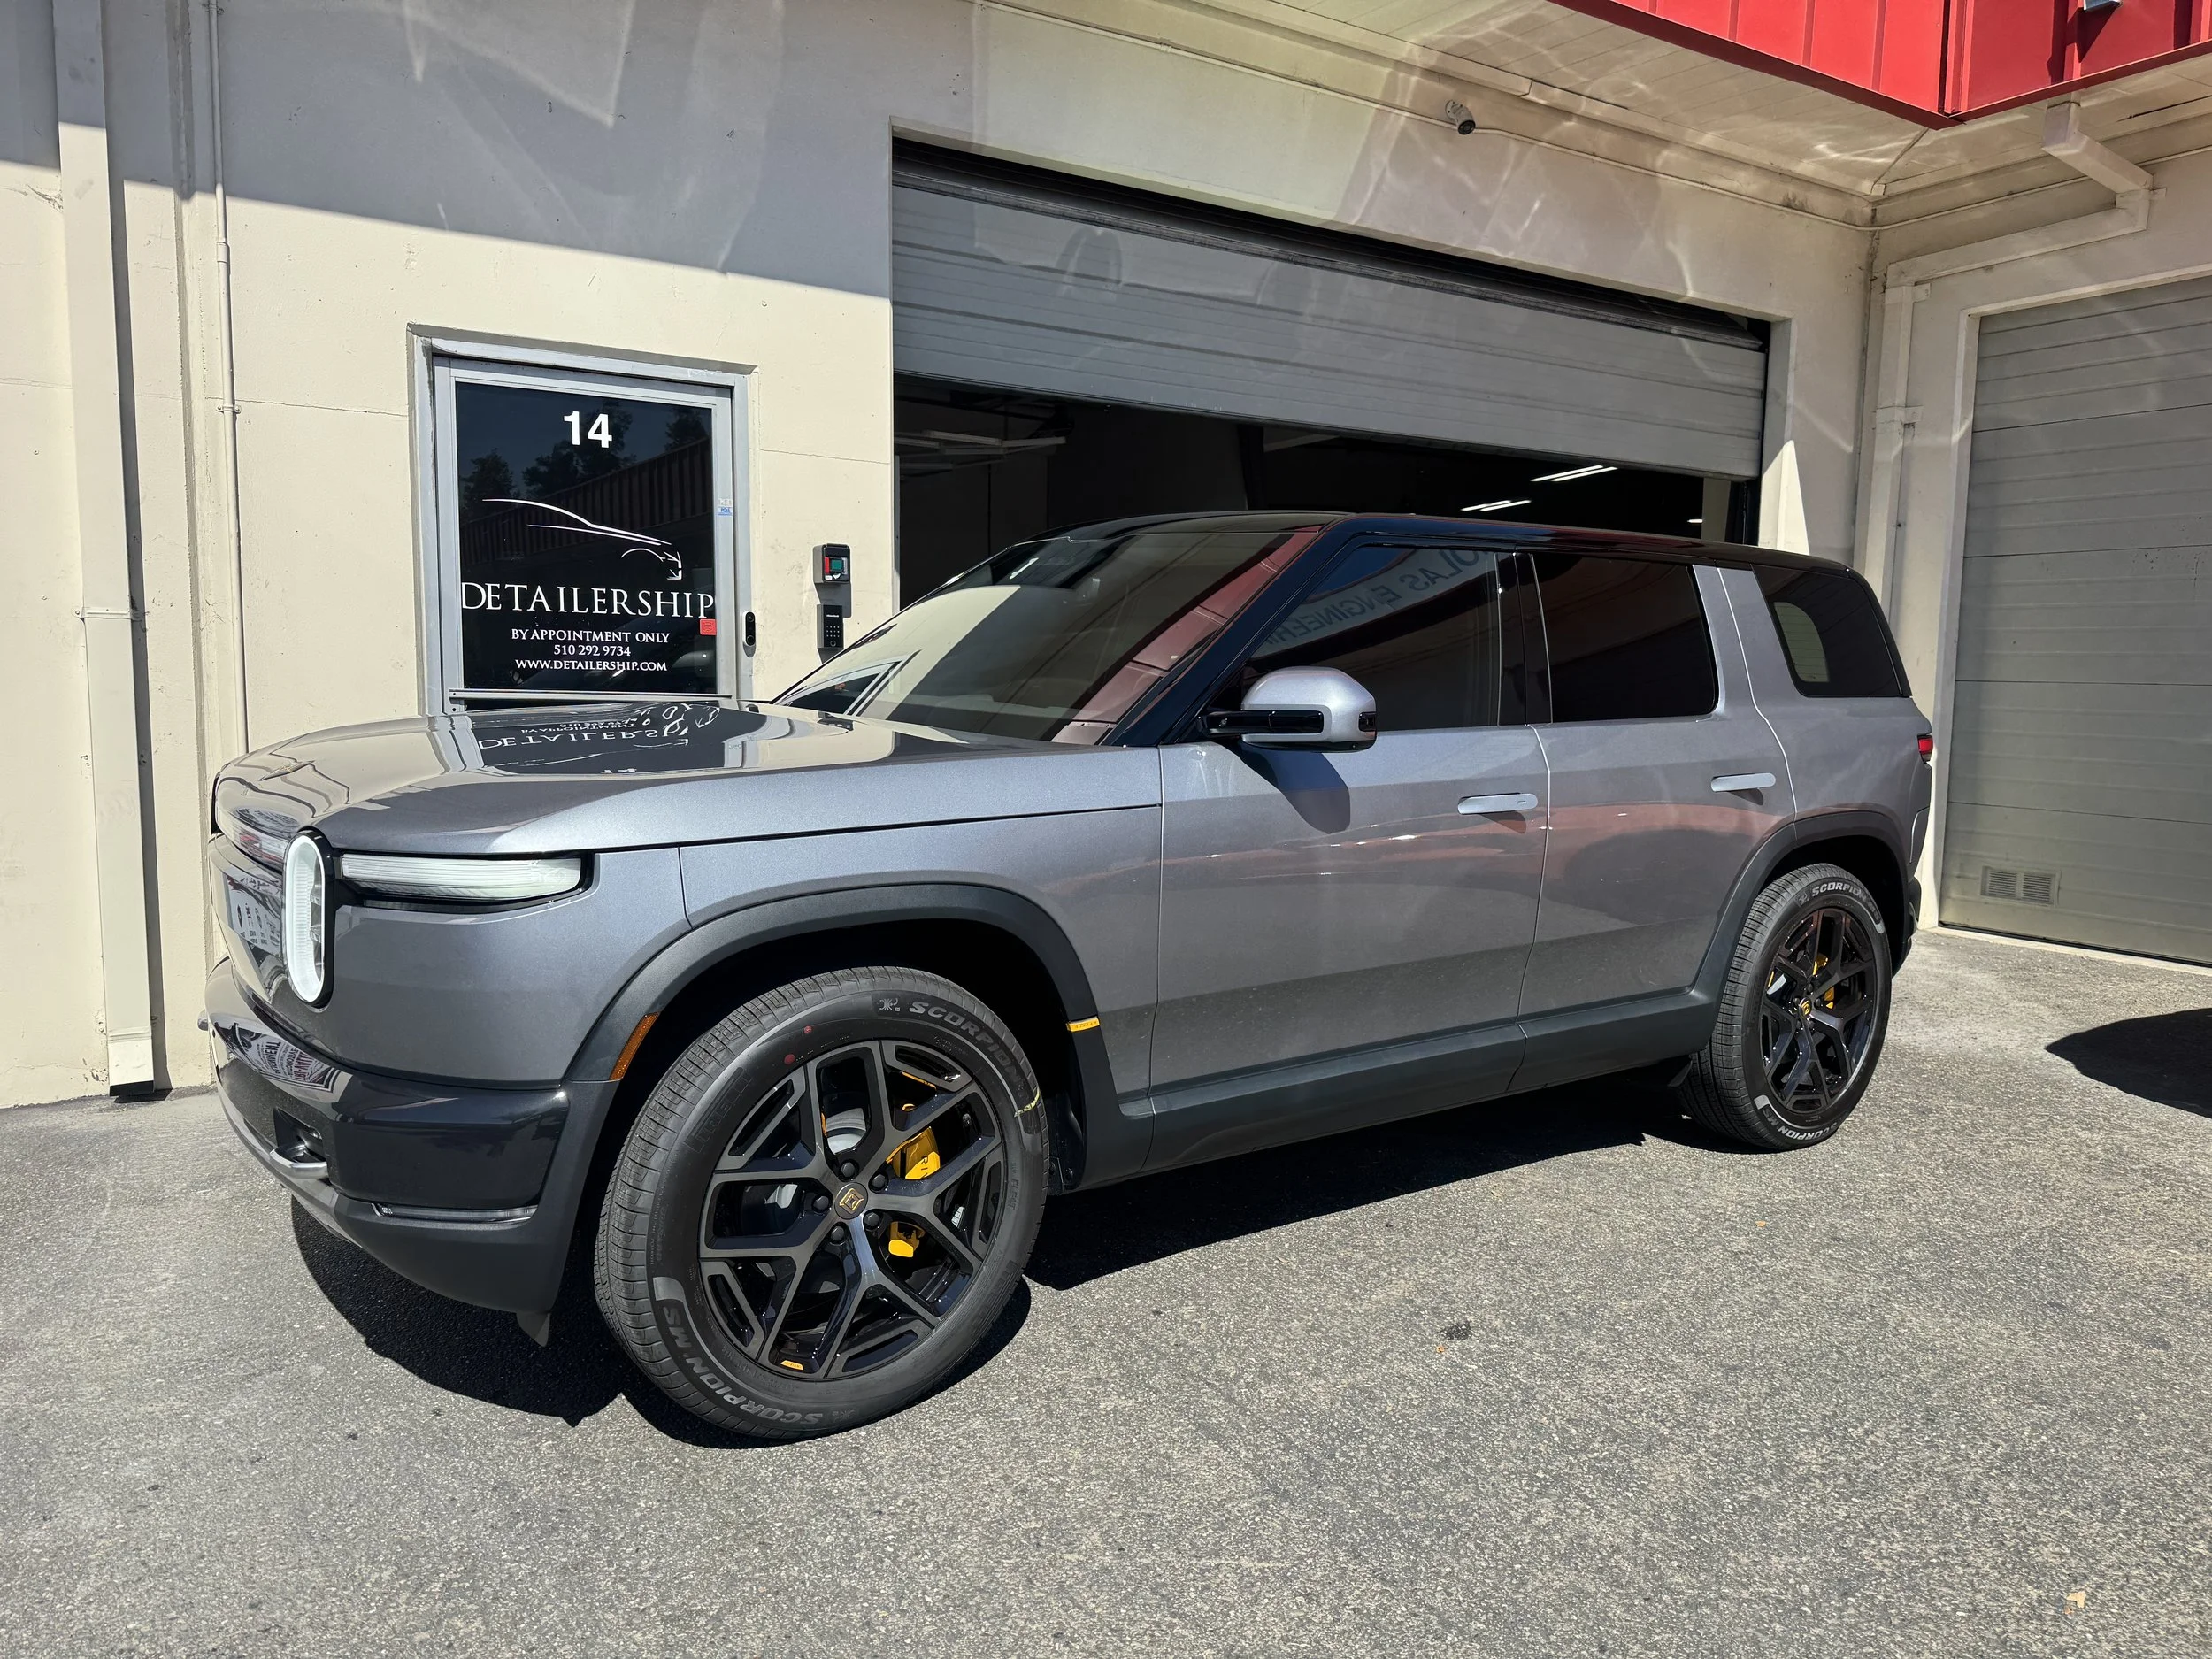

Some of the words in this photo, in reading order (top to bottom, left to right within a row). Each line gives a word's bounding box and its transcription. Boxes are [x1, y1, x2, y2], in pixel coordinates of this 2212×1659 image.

[563, 411, 613, 449] 14
[461, 581, 715, 619] DETAILERSHIP
[511, 628, 529, 641] BY
[530, 629, 632, 643] APPOINTMENT
[634, 632, 671, 643] ONLY
[553, 644, 576, 656] 510
[578, 645, 601, 657] 292
[603, 645, 632, 657] 9734
[515, 659, 668, 672] WWW.DETAILERSHIP.COM
[1810, 881, 1868, 902] SCORPION
[908, 1000, 1021, 1082] SCORPION
[684, 1355, 824, 1425] SCORPION
